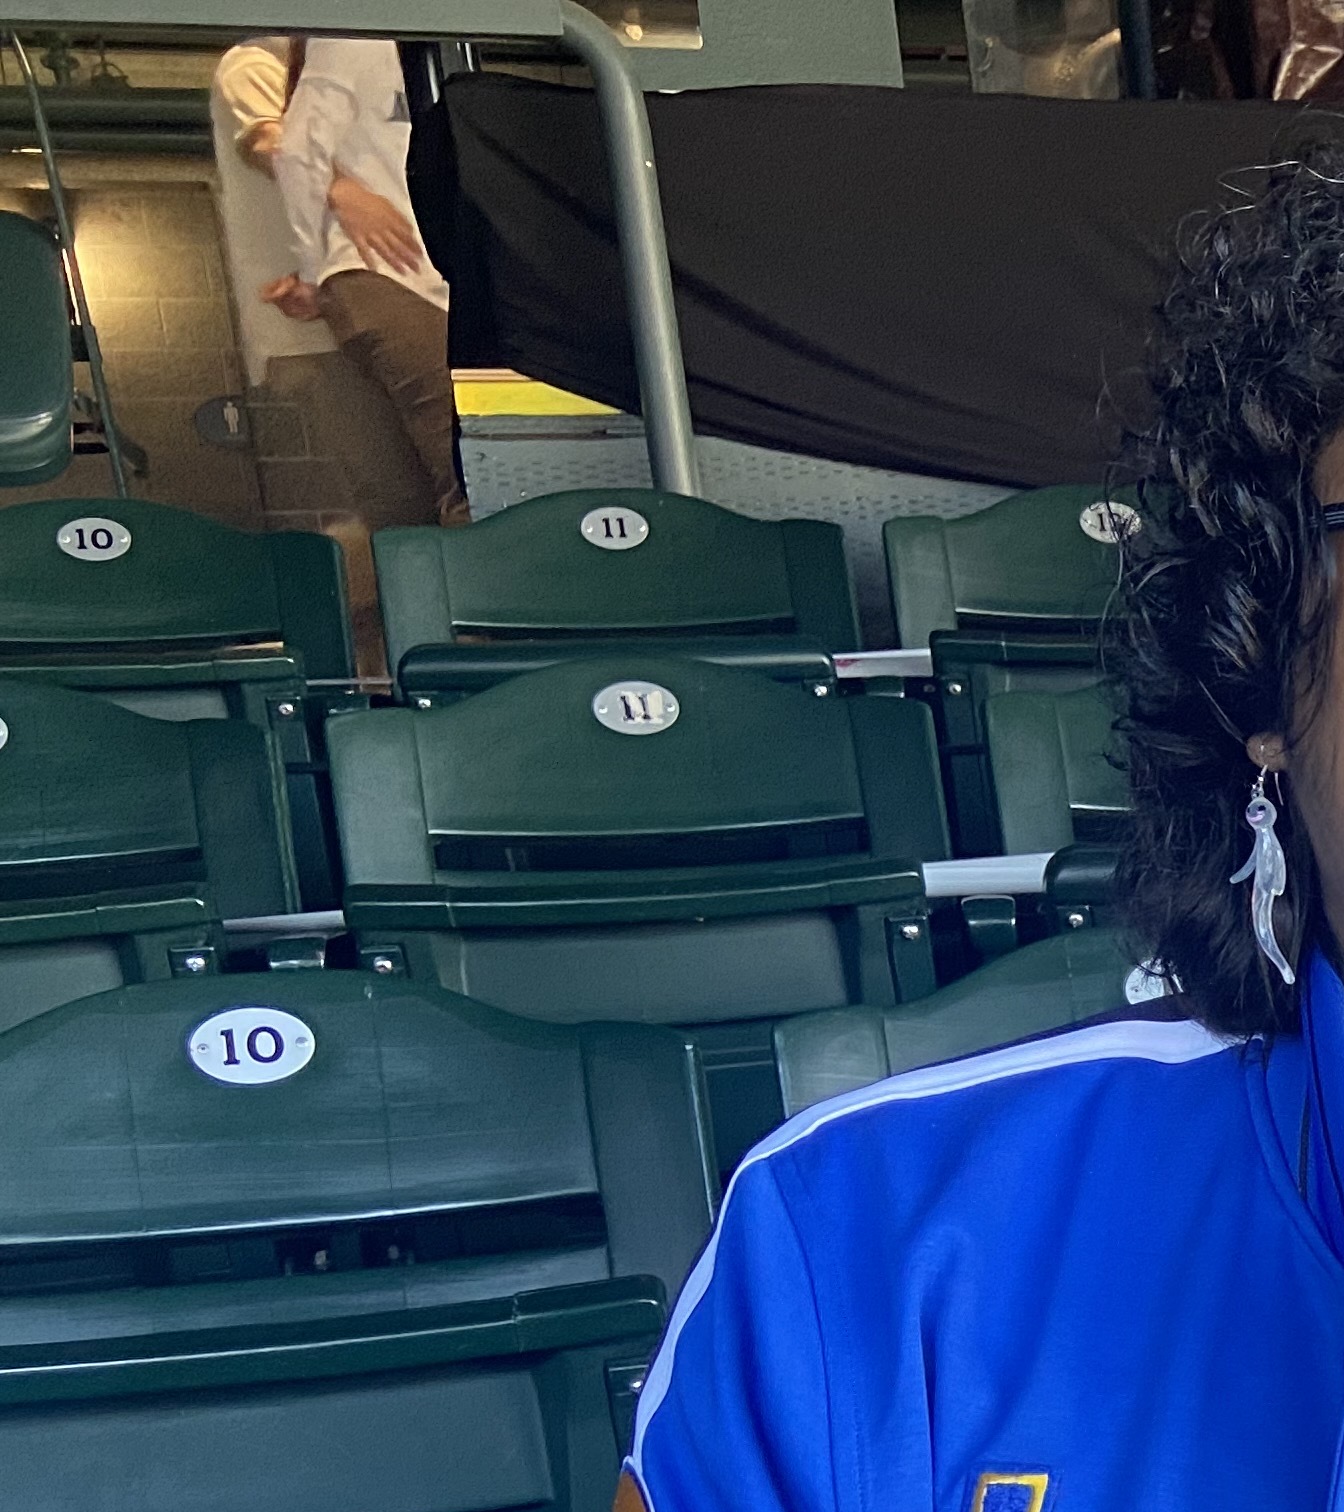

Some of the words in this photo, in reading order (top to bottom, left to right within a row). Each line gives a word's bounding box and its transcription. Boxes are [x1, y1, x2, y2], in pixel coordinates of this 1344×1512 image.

[75, 527, 114, 550] 10
[602, 517, 628, 539] 11
[220, 1025, 285, 1066] 10
